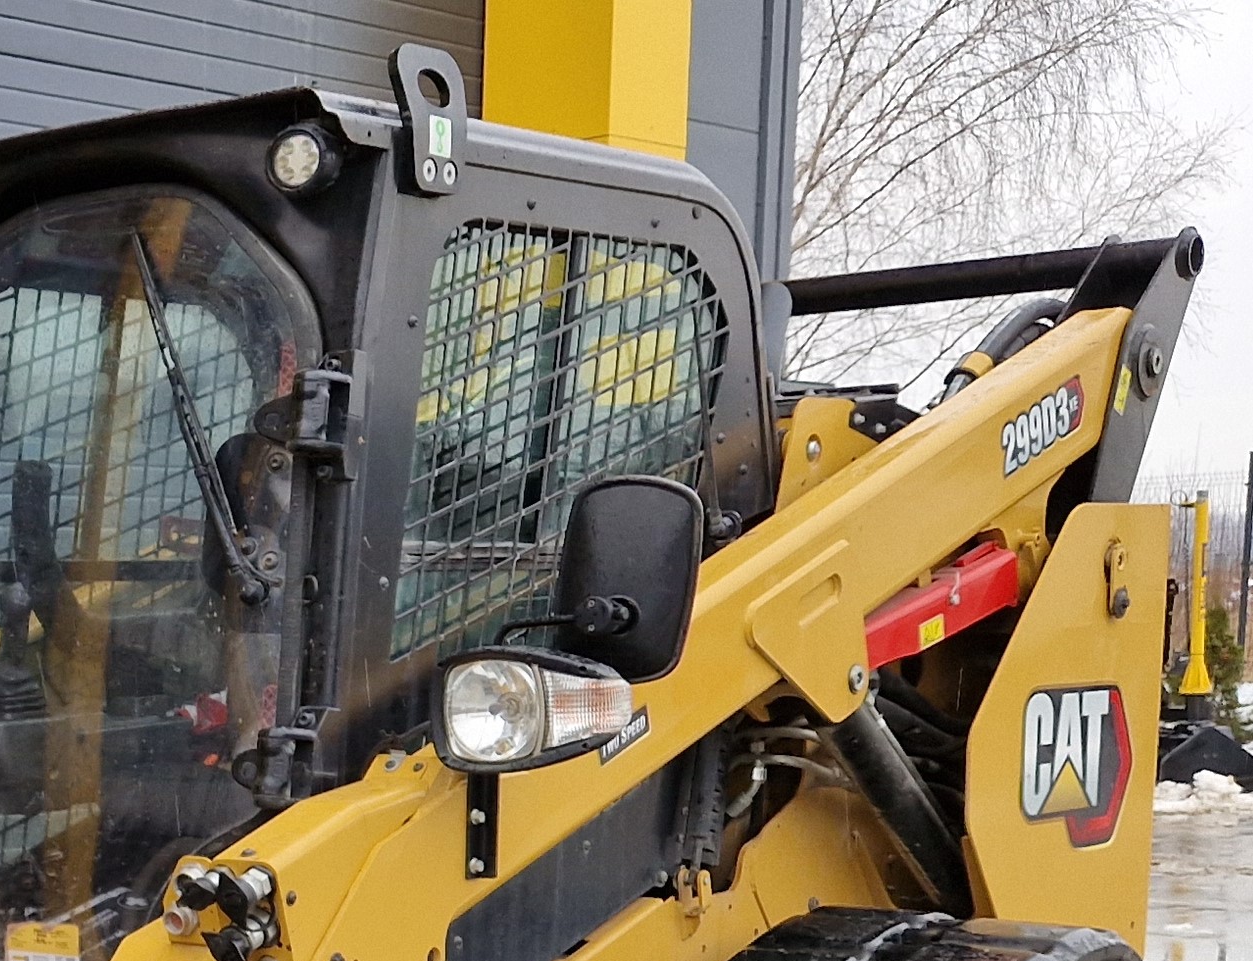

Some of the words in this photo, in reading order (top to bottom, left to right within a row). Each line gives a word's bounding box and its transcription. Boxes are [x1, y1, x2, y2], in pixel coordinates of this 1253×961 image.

[1002, 386, 1070, 476] 299D3
[620, 714, 646, 745] SPEED
[1023, 689, 1110, 816] CAT
